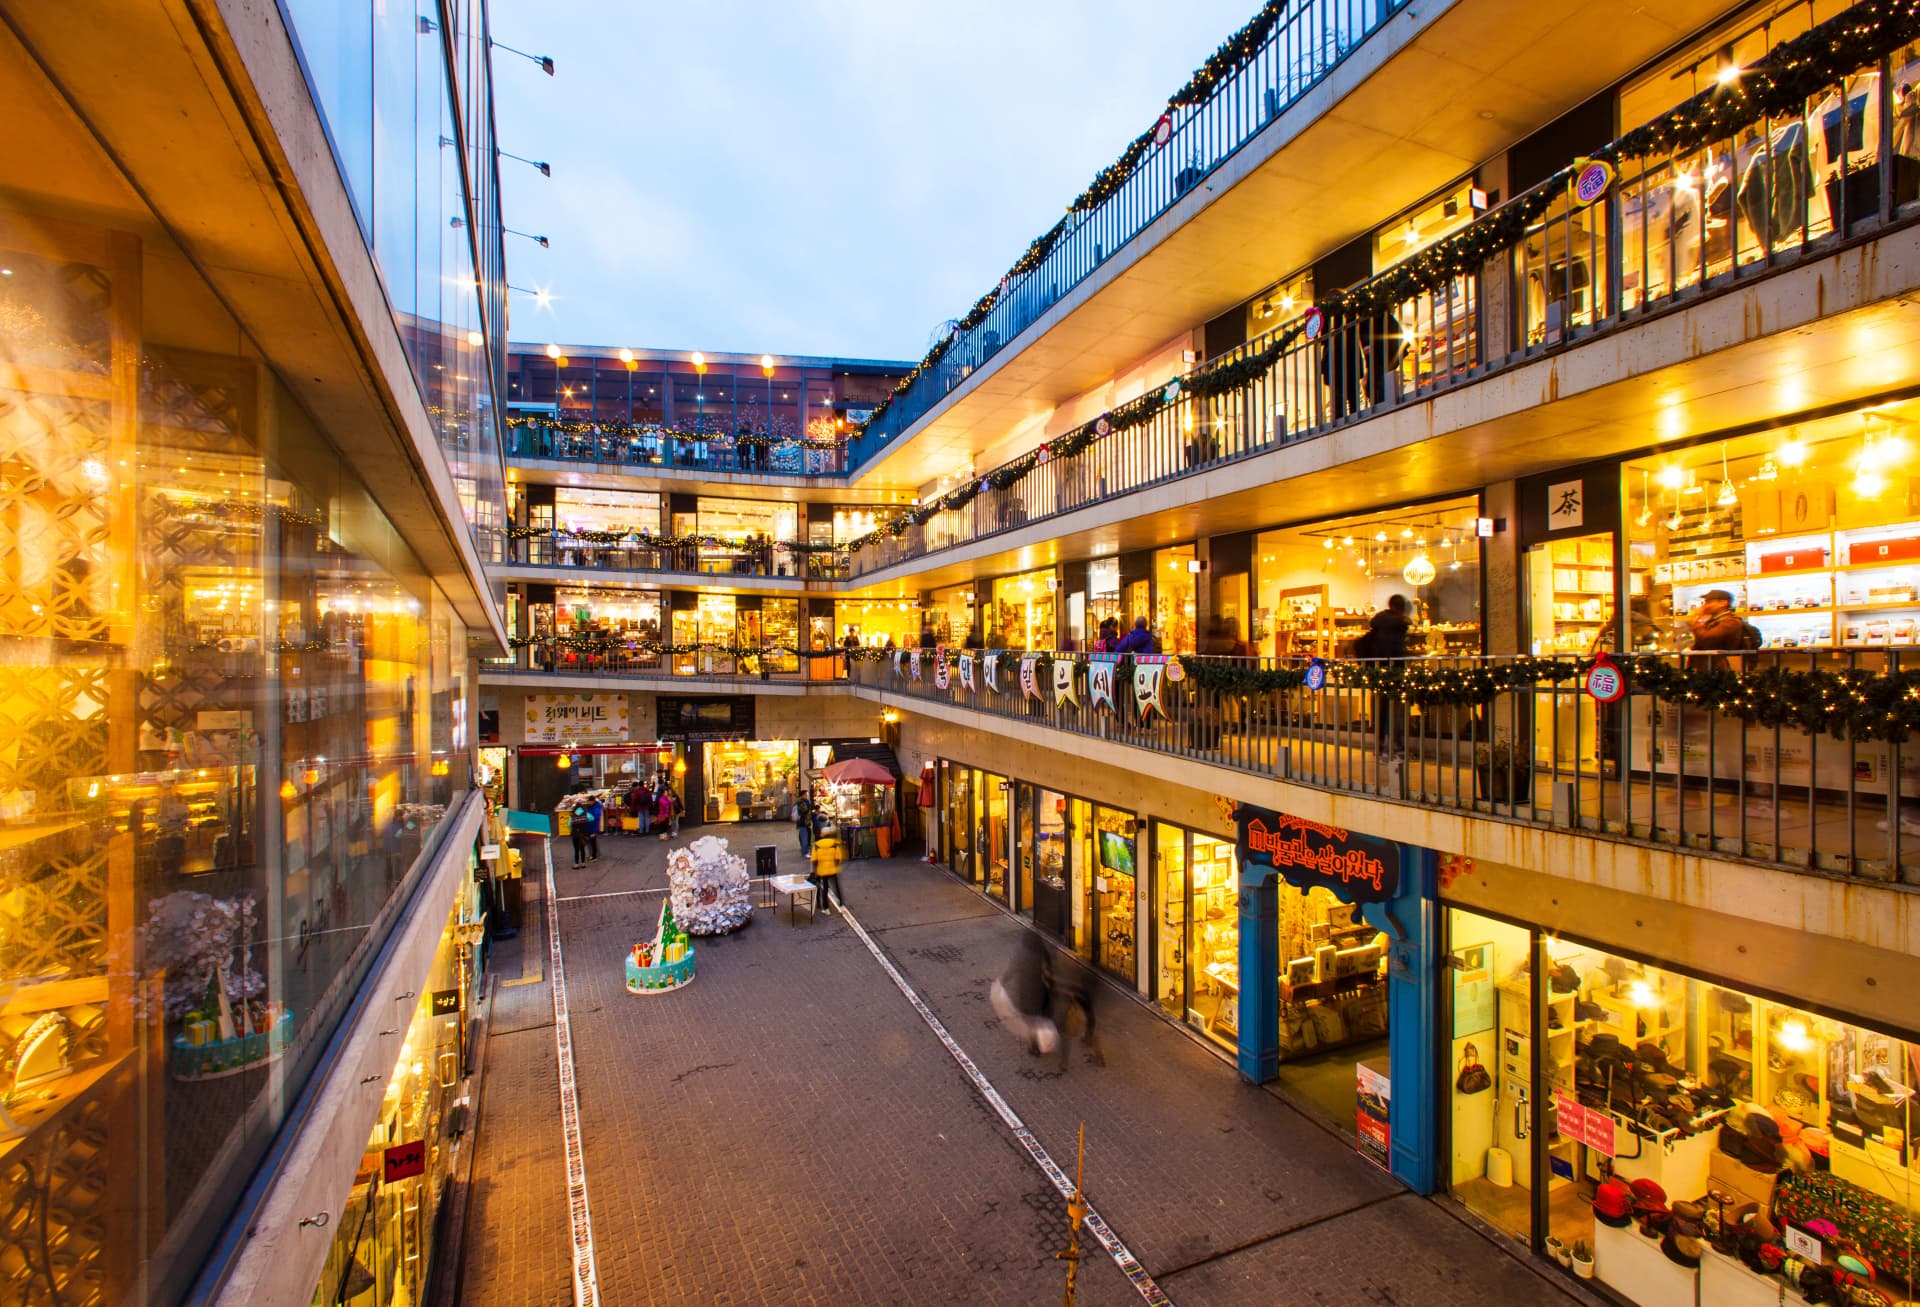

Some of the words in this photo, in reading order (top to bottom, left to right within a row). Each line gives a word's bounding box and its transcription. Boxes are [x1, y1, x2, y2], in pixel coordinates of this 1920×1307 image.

[1551, 488, 1581, 517] 茶
[1056, 667, 1070, 690] 으
[1093, 669, 1110, 697] 세
[1592, 673, 1616, 694] 福
